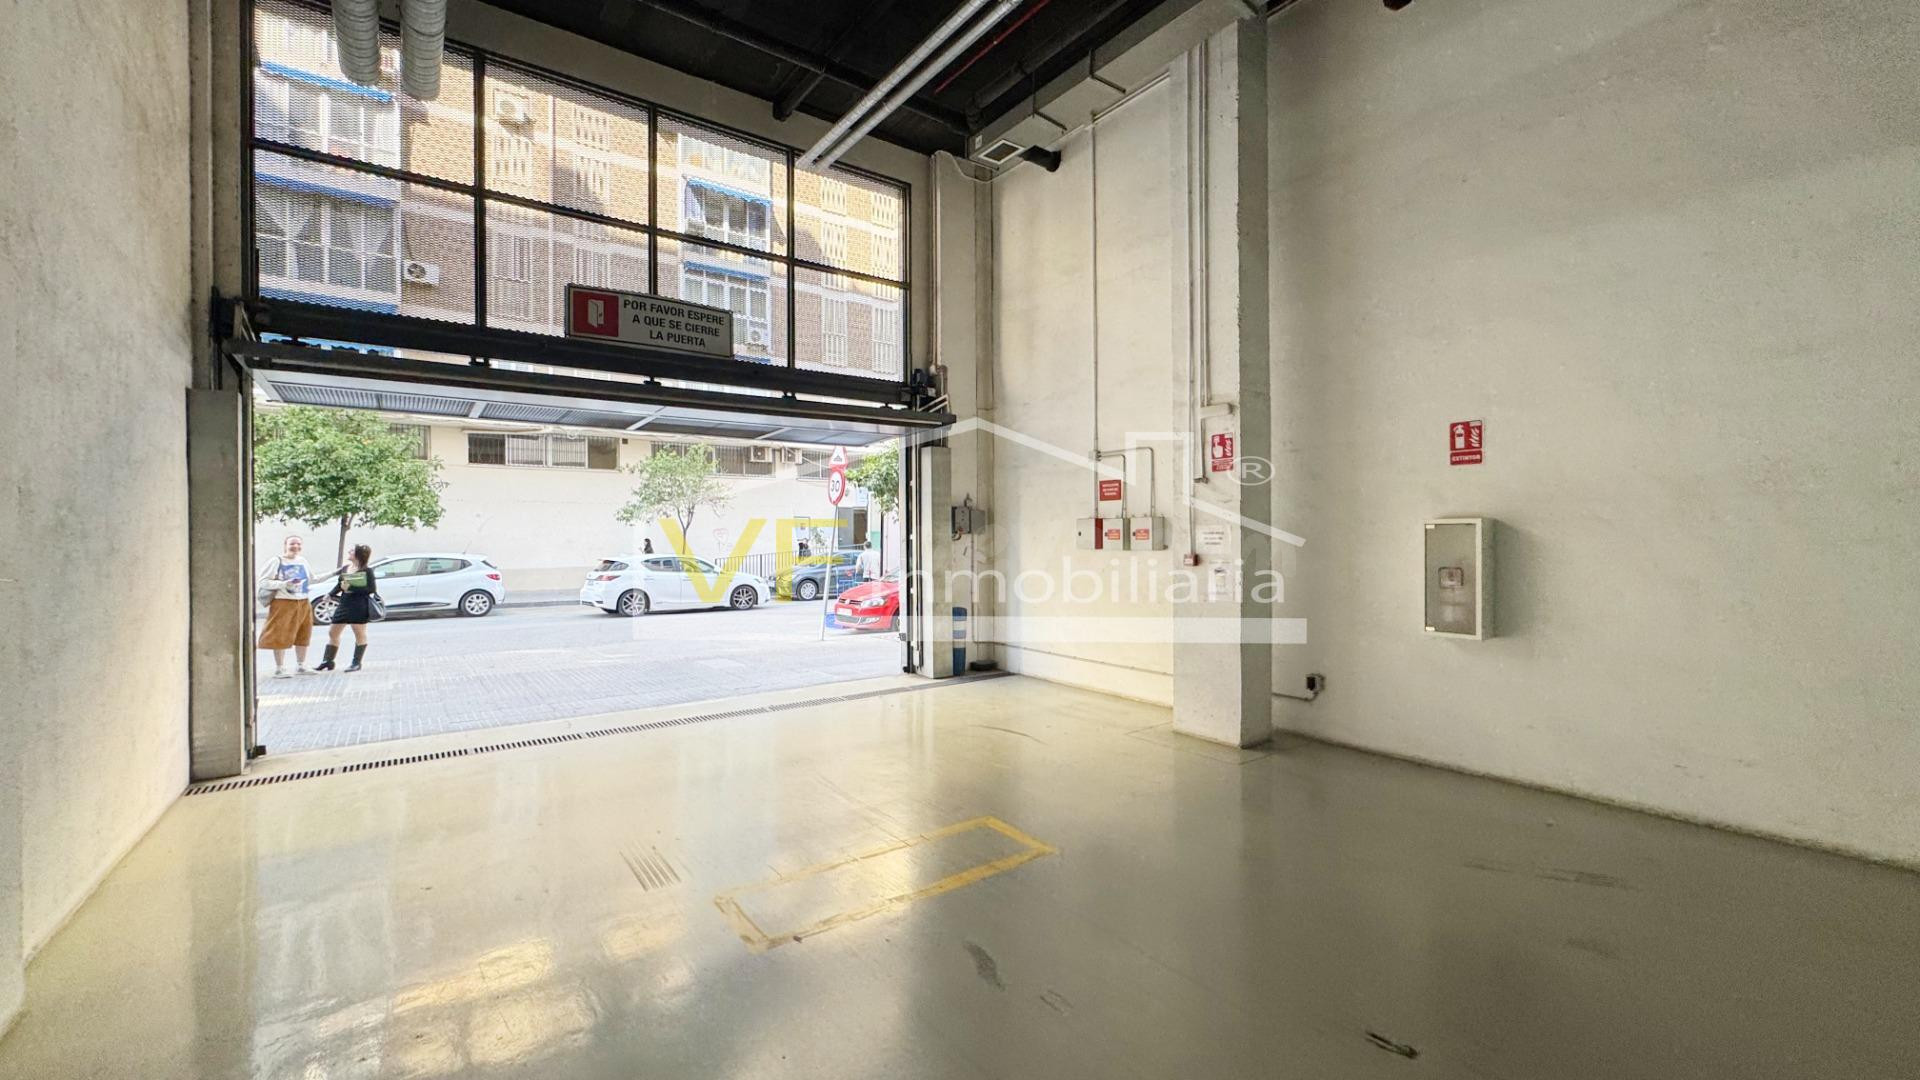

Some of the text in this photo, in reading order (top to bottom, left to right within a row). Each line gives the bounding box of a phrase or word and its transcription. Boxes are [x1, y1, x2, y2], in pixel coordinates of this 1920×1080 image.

[623, 299, 725, 326] POR FAVOR ESPERE
[632, 314, 720, 337] A QUE SE CIERRE
[649, 329, 706, 348] LA PUERTA
[831, 479, 840, 491] 30
